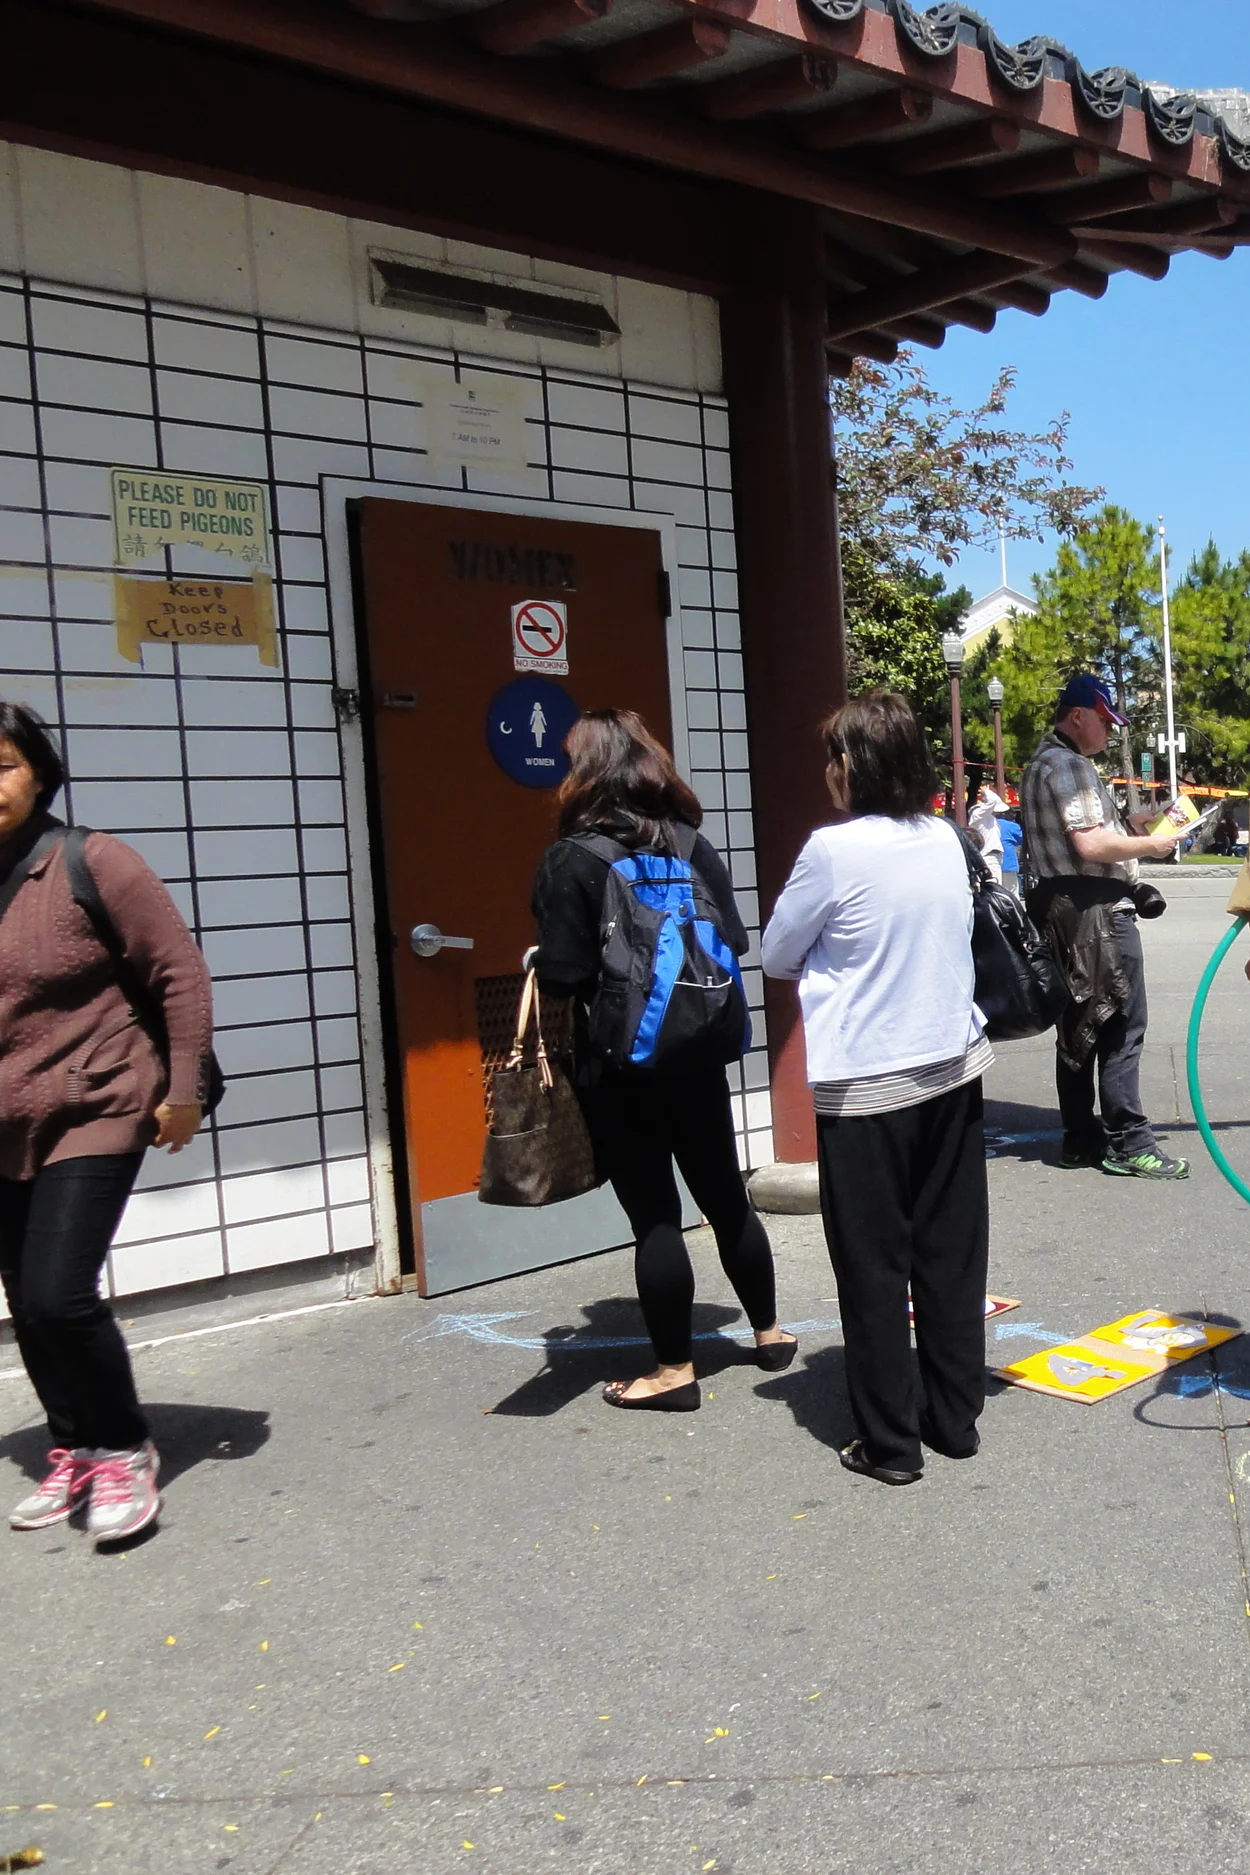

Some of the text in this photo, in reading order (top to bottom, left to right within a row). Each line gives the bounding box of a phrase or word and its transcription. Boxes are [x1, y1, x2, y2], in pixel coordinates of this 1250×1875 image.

[458, 434, 469, 442] AM
[489, 437, 500, 445] PM
[119, 479, 258, 513] PLEASE DO NOT
[128, 506, 254, 537] FEED PIGEONS
[447, 540, 577, 589] WOMEN
[168, 583, 224, 599] Keep
[162, 602, 228, 615] Doors
[145, 616, 244, 638] Closed
[516, 659, 568, 669] NO SMOKING
[525, 757, 555, 767] WOMEN
